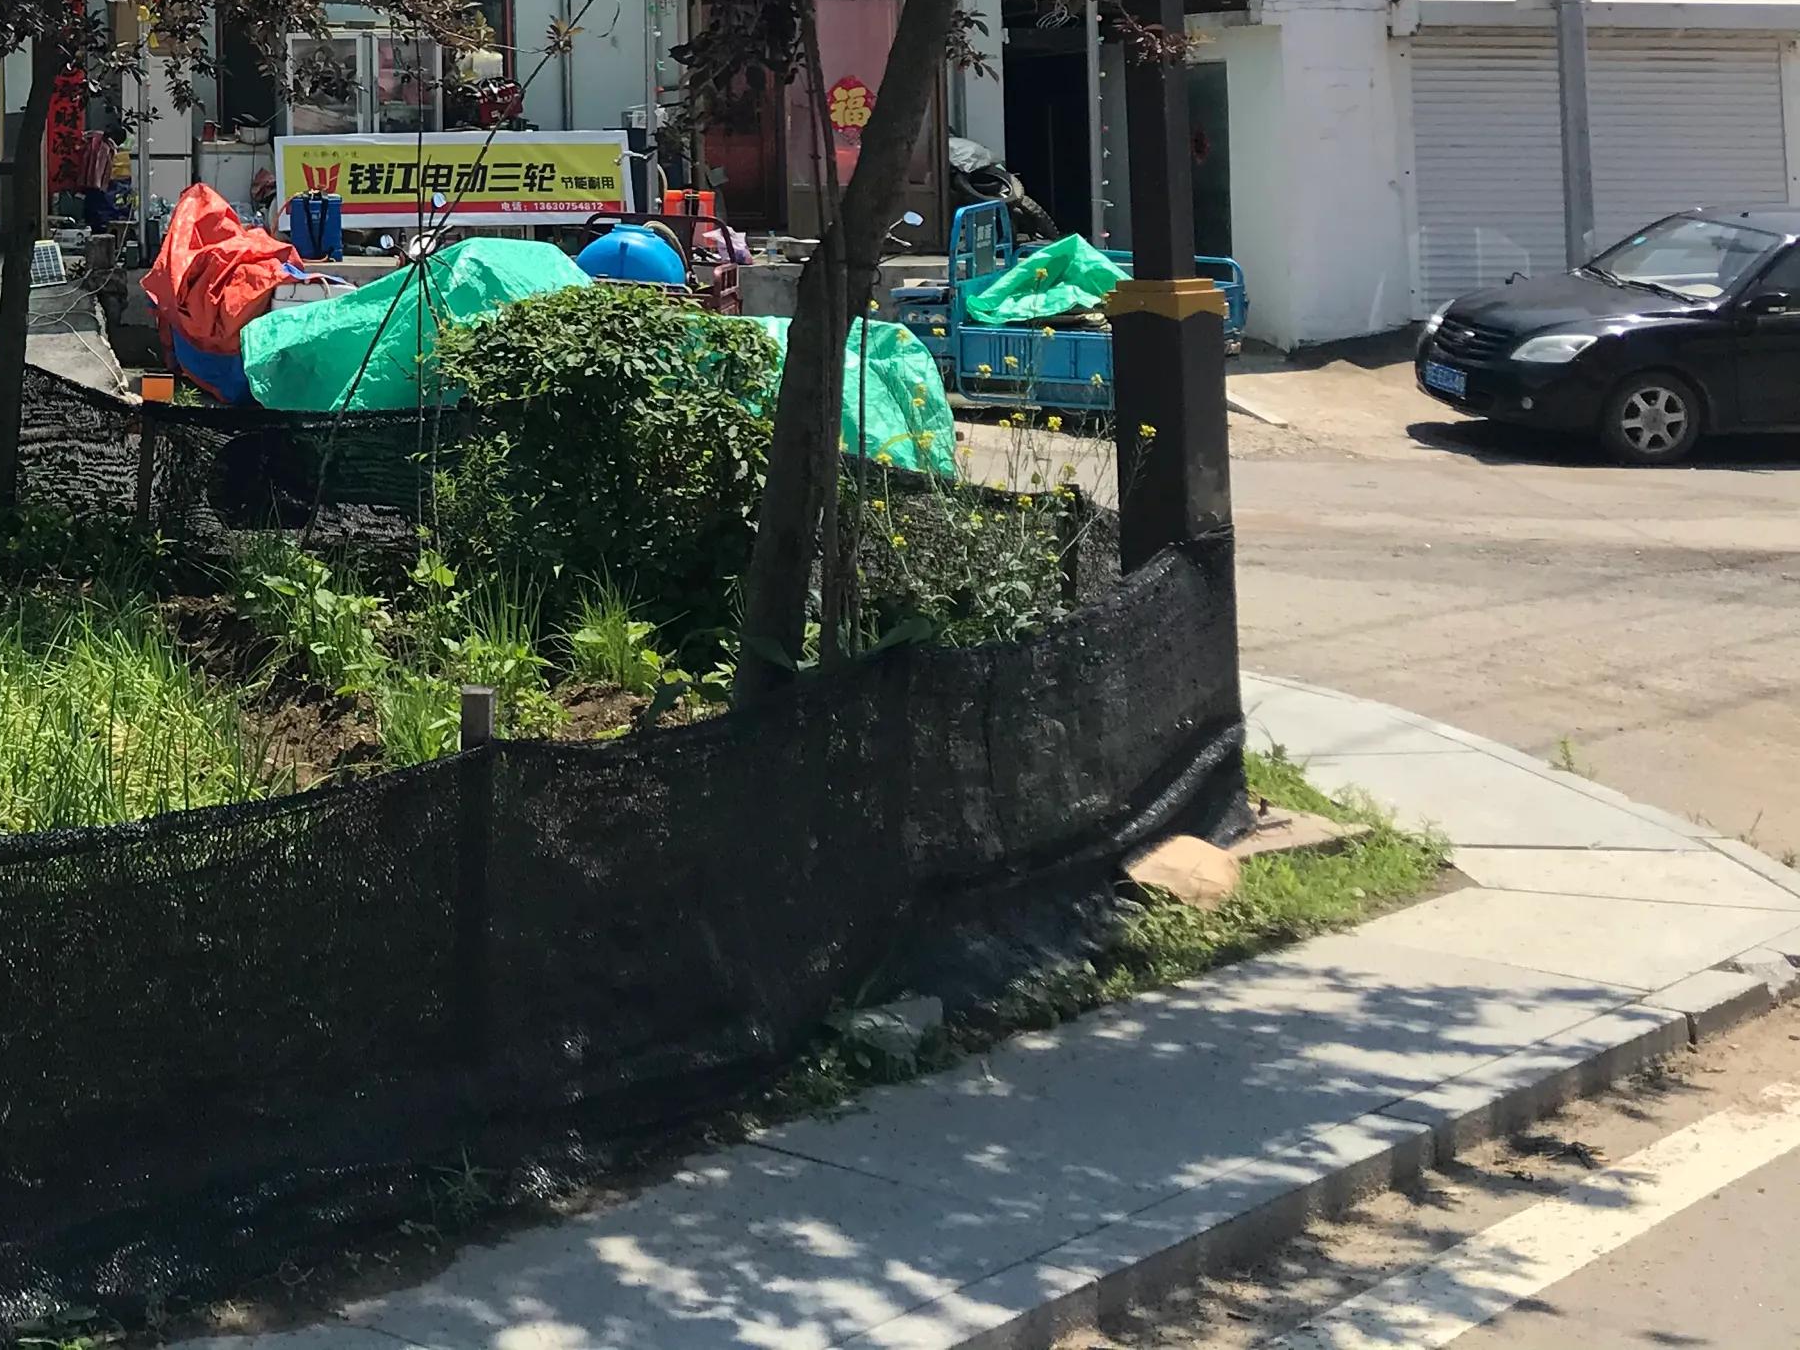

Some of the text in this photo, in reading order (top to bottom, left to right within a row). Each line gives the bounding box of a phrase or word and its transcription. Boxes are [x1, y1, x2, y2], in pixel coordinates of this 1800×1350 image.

[830, 87, 872, 127] 福
[348, 162, 615, 195] 钱江电动三轮 节能耐用
[533, 202, 604, 212] 13630754812
